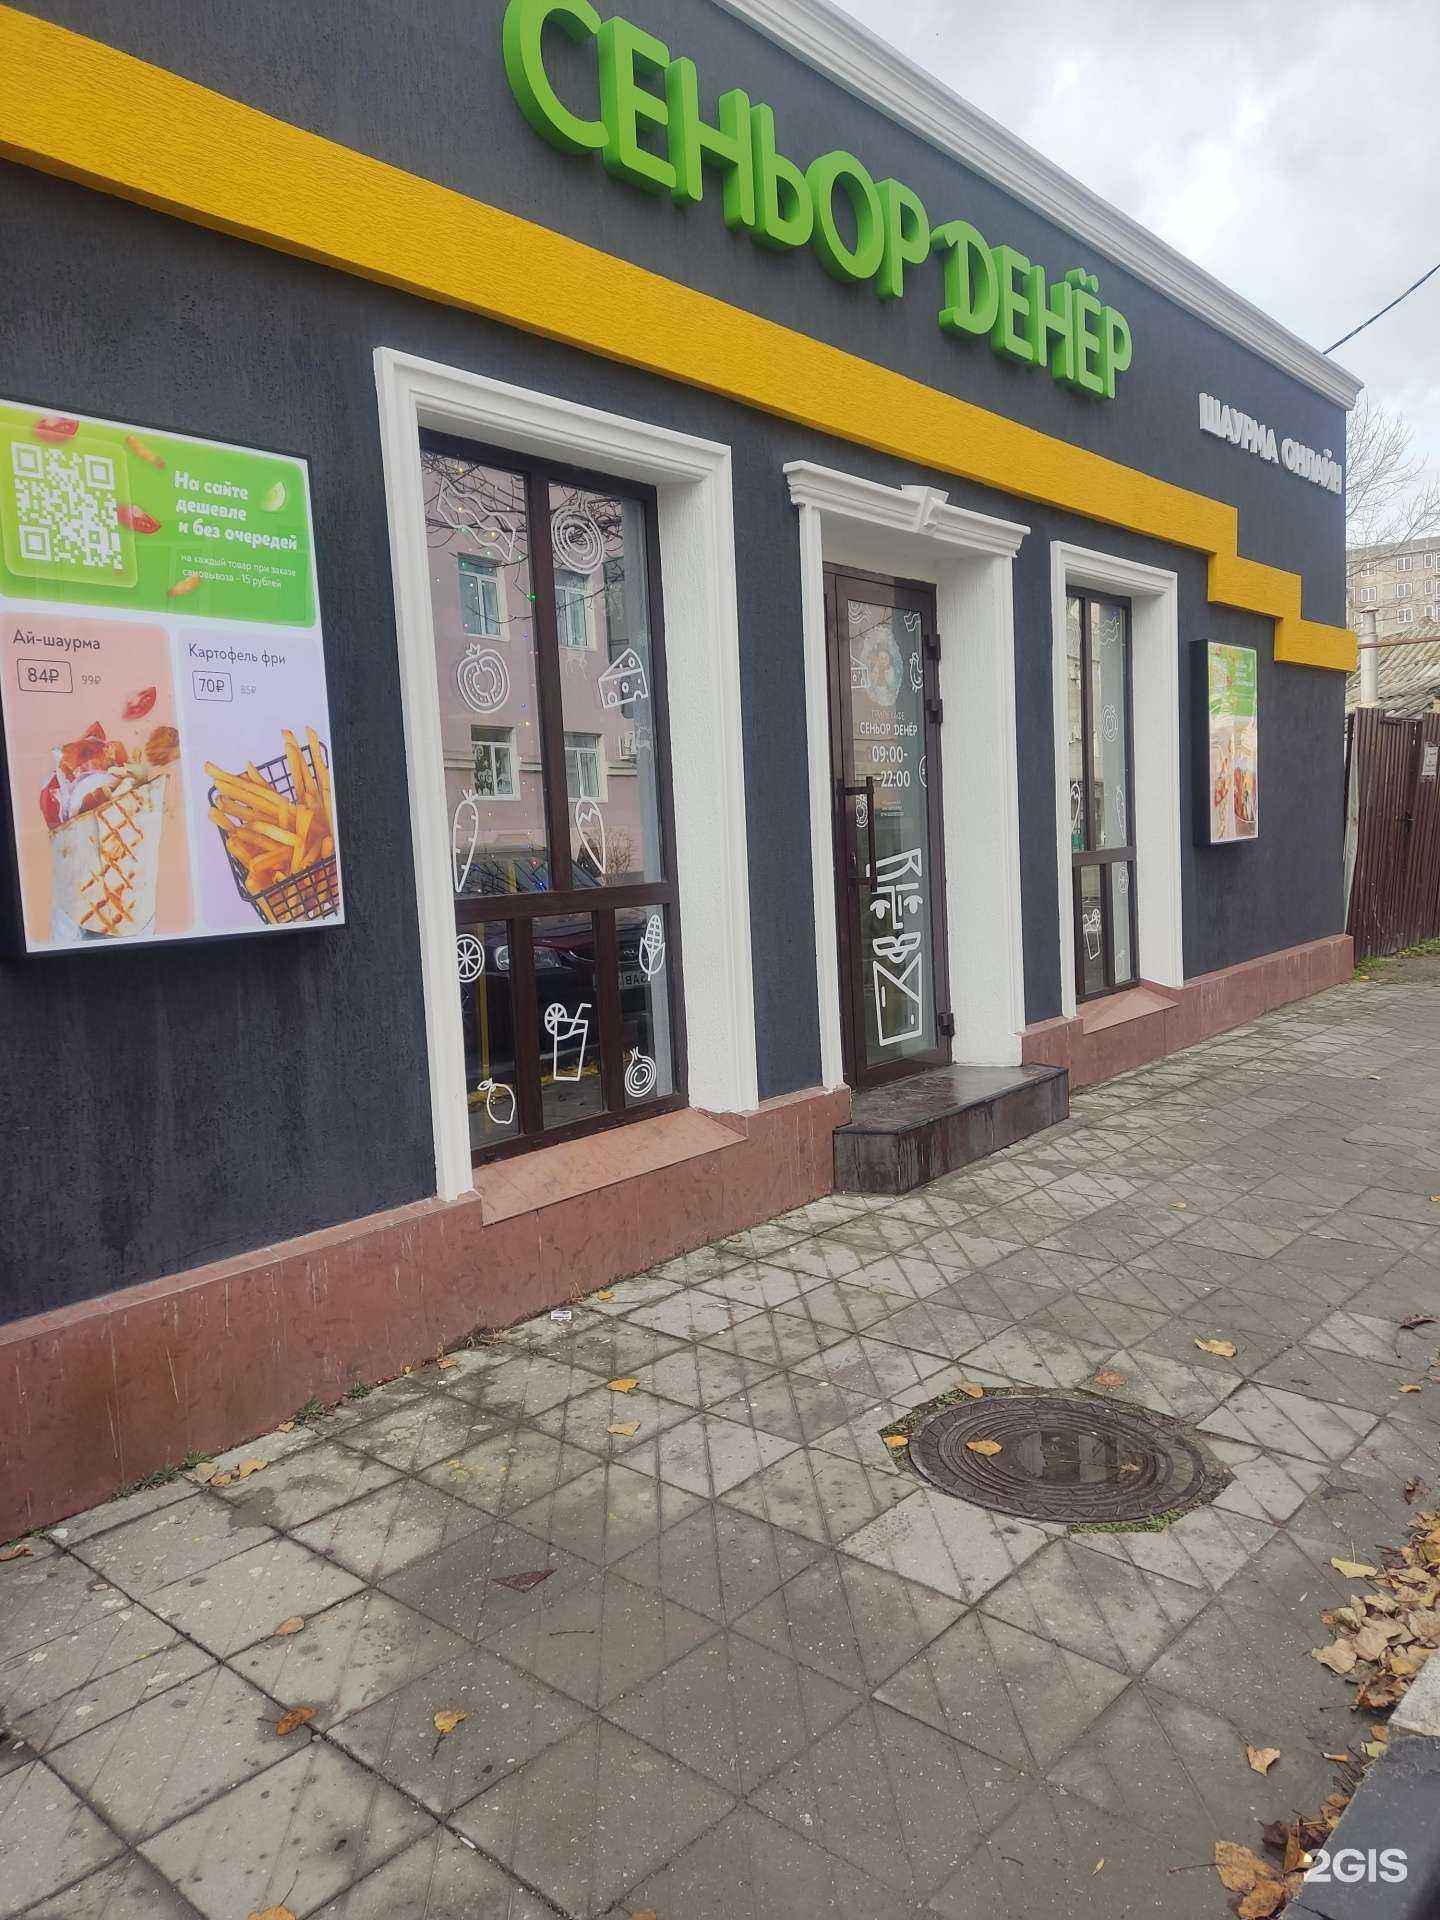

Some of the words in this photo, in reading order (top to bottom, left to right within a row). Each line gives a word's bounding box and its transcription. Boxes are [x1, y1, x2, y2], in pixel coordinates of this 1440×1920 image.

[1199, 392, 1280, 464] ШАУРМА
[174, 470, 200, 492] На
[204, 480, 249, 501] сайте
[175, 498, 247, 521] дешевле
[178, 521, 189, 534] и
[192, 518, 221, 539] без
[225, 527, 298, 551] очередей
[12, 628, 102, 653] Ай-шаурма
[188, 641, 259, 665] Картофель
[261, 648, 287, 668] фри
